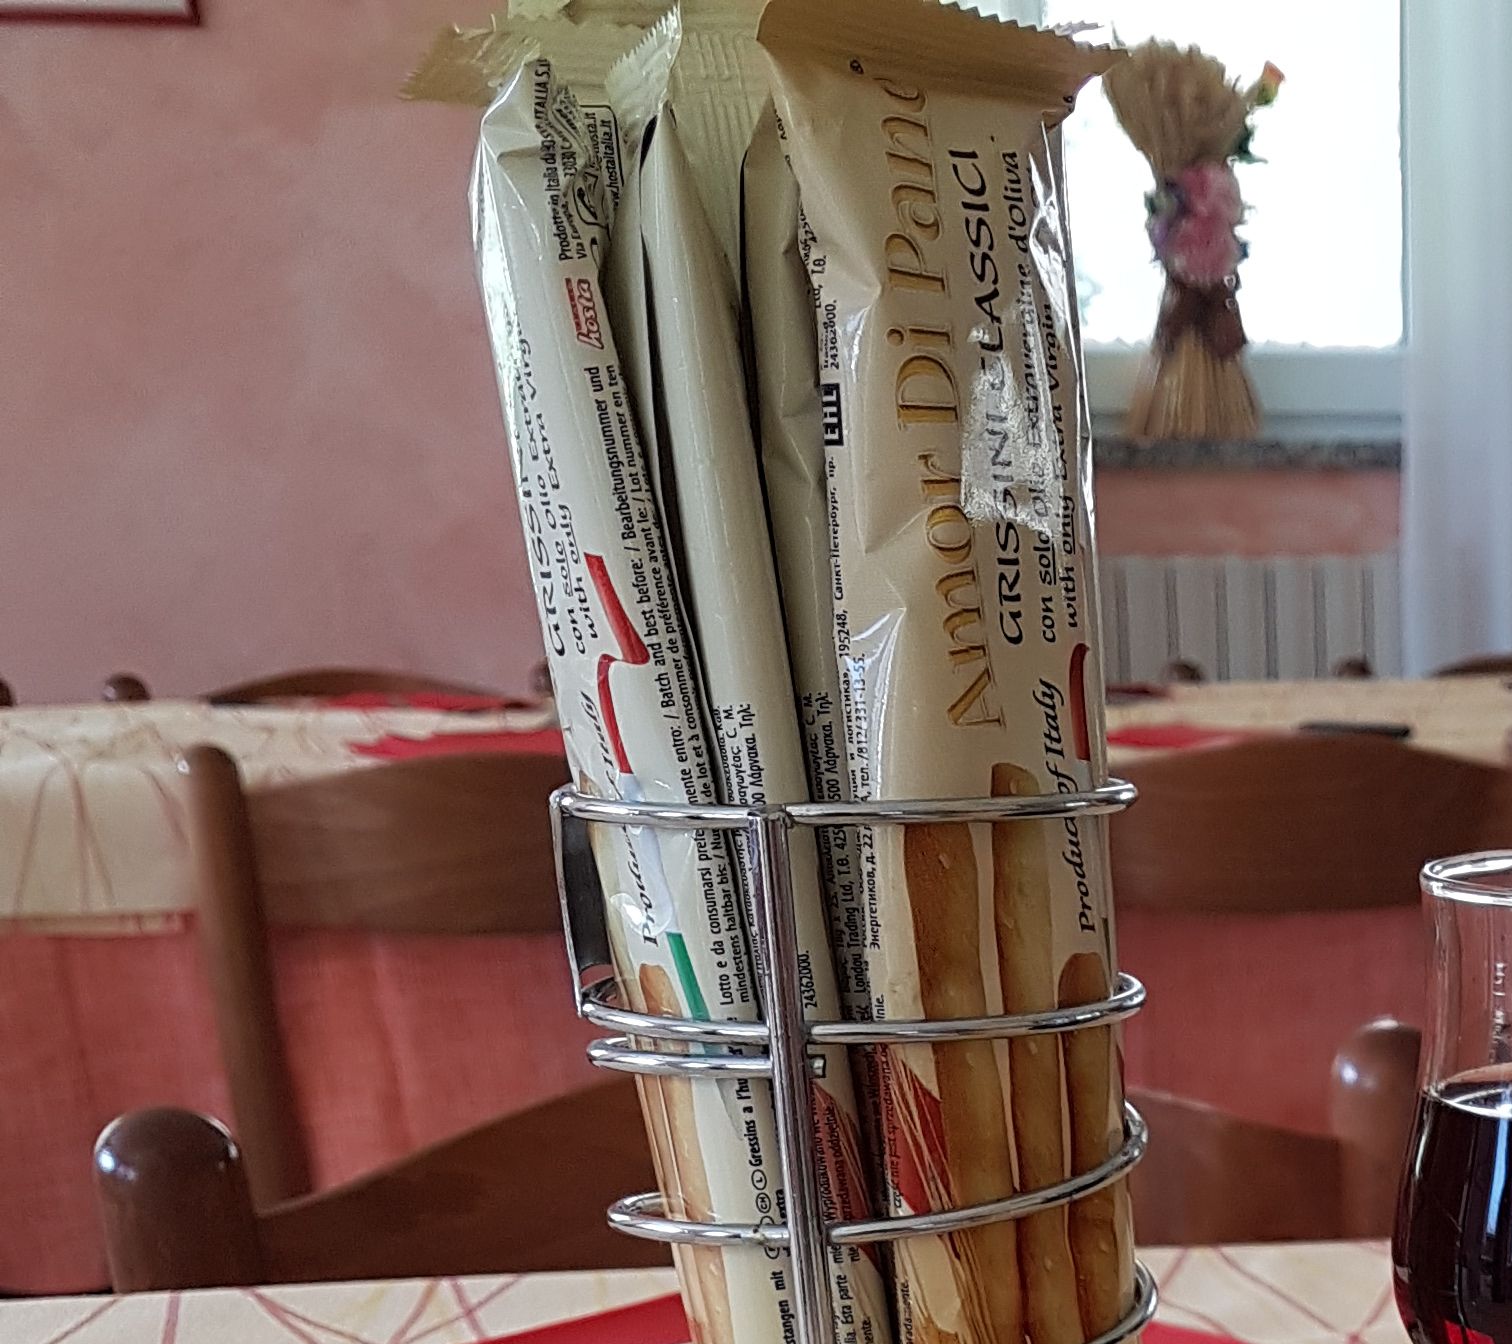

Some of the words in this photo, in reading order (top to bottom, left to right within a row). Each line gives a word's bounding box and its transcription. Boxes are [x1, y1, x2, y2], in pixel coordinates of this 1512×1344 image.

[1000, 151, 1029, 254] d'Oliva
[574, 278, 605, 350] hosta
[583, 366, 605, 392] und
[603, 364, 620, 387] ten
[609, 390, 623, 408] en
[882, 325, 963, 432] Di
[535, 413, 561, 491] Extra
[612, 411, 637, 468] nummer
[594, 398, 639, 540] Bearbeitungsnummer
[625, 471, 642, 494] Lot
[537, 474, 558, 532] Olio
[637, 506, 652, 524] le:
[1056, 495, 1077, 556] only
[557, 504, 582, 566] only
[643, 529, 659, 563] avant
[825, 486, 846, 602] Санкт-Петербург,
[1033, 530, 1057, 586] solo
[554, 540, 575, 598] solo
[629, 556, 652, 603] before:
[916, 451, 1007, 729] Amor
[573, 577, 599, 640] with
[650, 566, 675, 634] préférence
[1032, 597, 1057, 644] con
[1054, 566, 1079, 629] with
[565, 608, 587, 655] con
[640, 608, 660, 636] best
[664, 638, 679, 654] de
[835, 608, 852, 659] 195248,
[647, 642, 668, 666] and
[655, 671, 678, 708] Batch
[674, 656, 698, 730] consommer
[1031, 677, 1066, 760] Italy
[669, 726, 688, 763] entro:
[690, 744, 704, 759] et
[741, 732, 765, 789] Λάρνακα.
[819, 720, 843, 775] Λάρνακα.
[693, 761, 708, 778] lot
[699, 782, 713, 798] de
[862, 834, 874, 848] 22
[1061, 816, 1096, 934] Produc
[696, 867, 720, 935] consumarsi
[716, 887, 739, 932] haltbar
[863, 866, 882, 951] Энергетиков,
[709, 939, 725, 955] da
[839, 907, 865, 949] Trading
[714, 960, 728, 968] e
[727, 934, 751, 1004] mindestens
[799, 950, 818, 1009] 24362000.
[716, 973, 736, 1006] Lotto
[738, 1105, 753, 1114] a
[739, 1118, 769, 1168] Gressins
[770, 1270, 787, 1291] mit
[832, 1273, 852, 1300] parte
[838, 1304, 853, 1325] Esta
